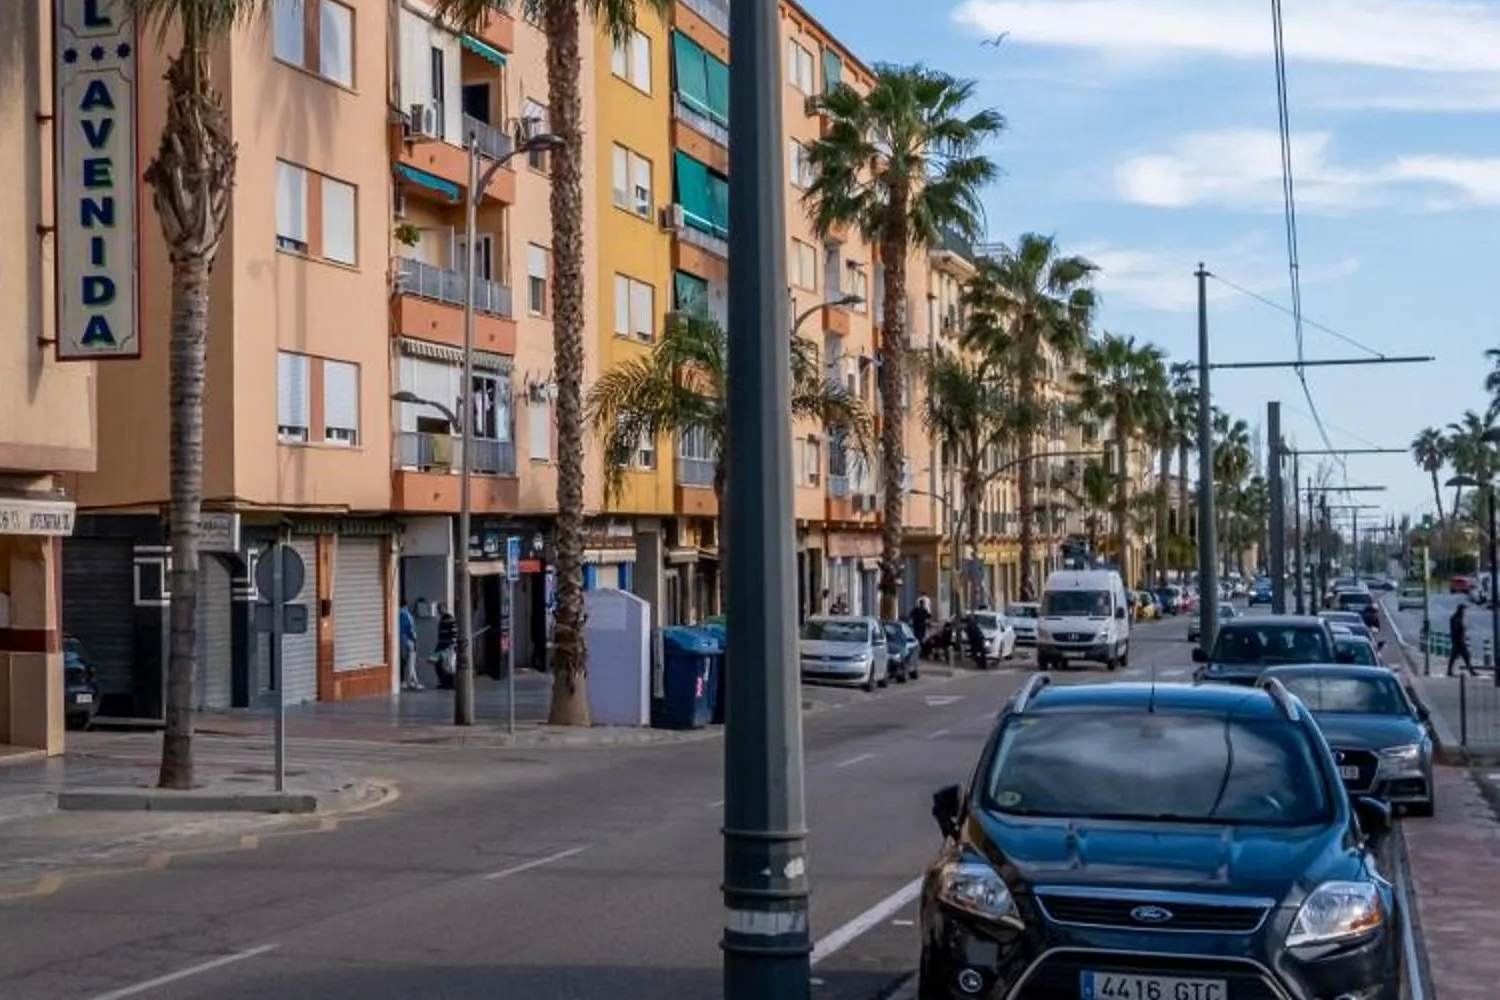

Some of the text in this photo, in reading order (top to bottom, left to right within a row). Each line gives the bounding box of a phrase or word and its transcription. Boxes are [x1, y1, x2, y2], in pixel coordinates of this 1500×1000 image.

[79, 79, 116, 347] AVENIDA
[1101, 975, 1221, 1000] 4416 GTC
